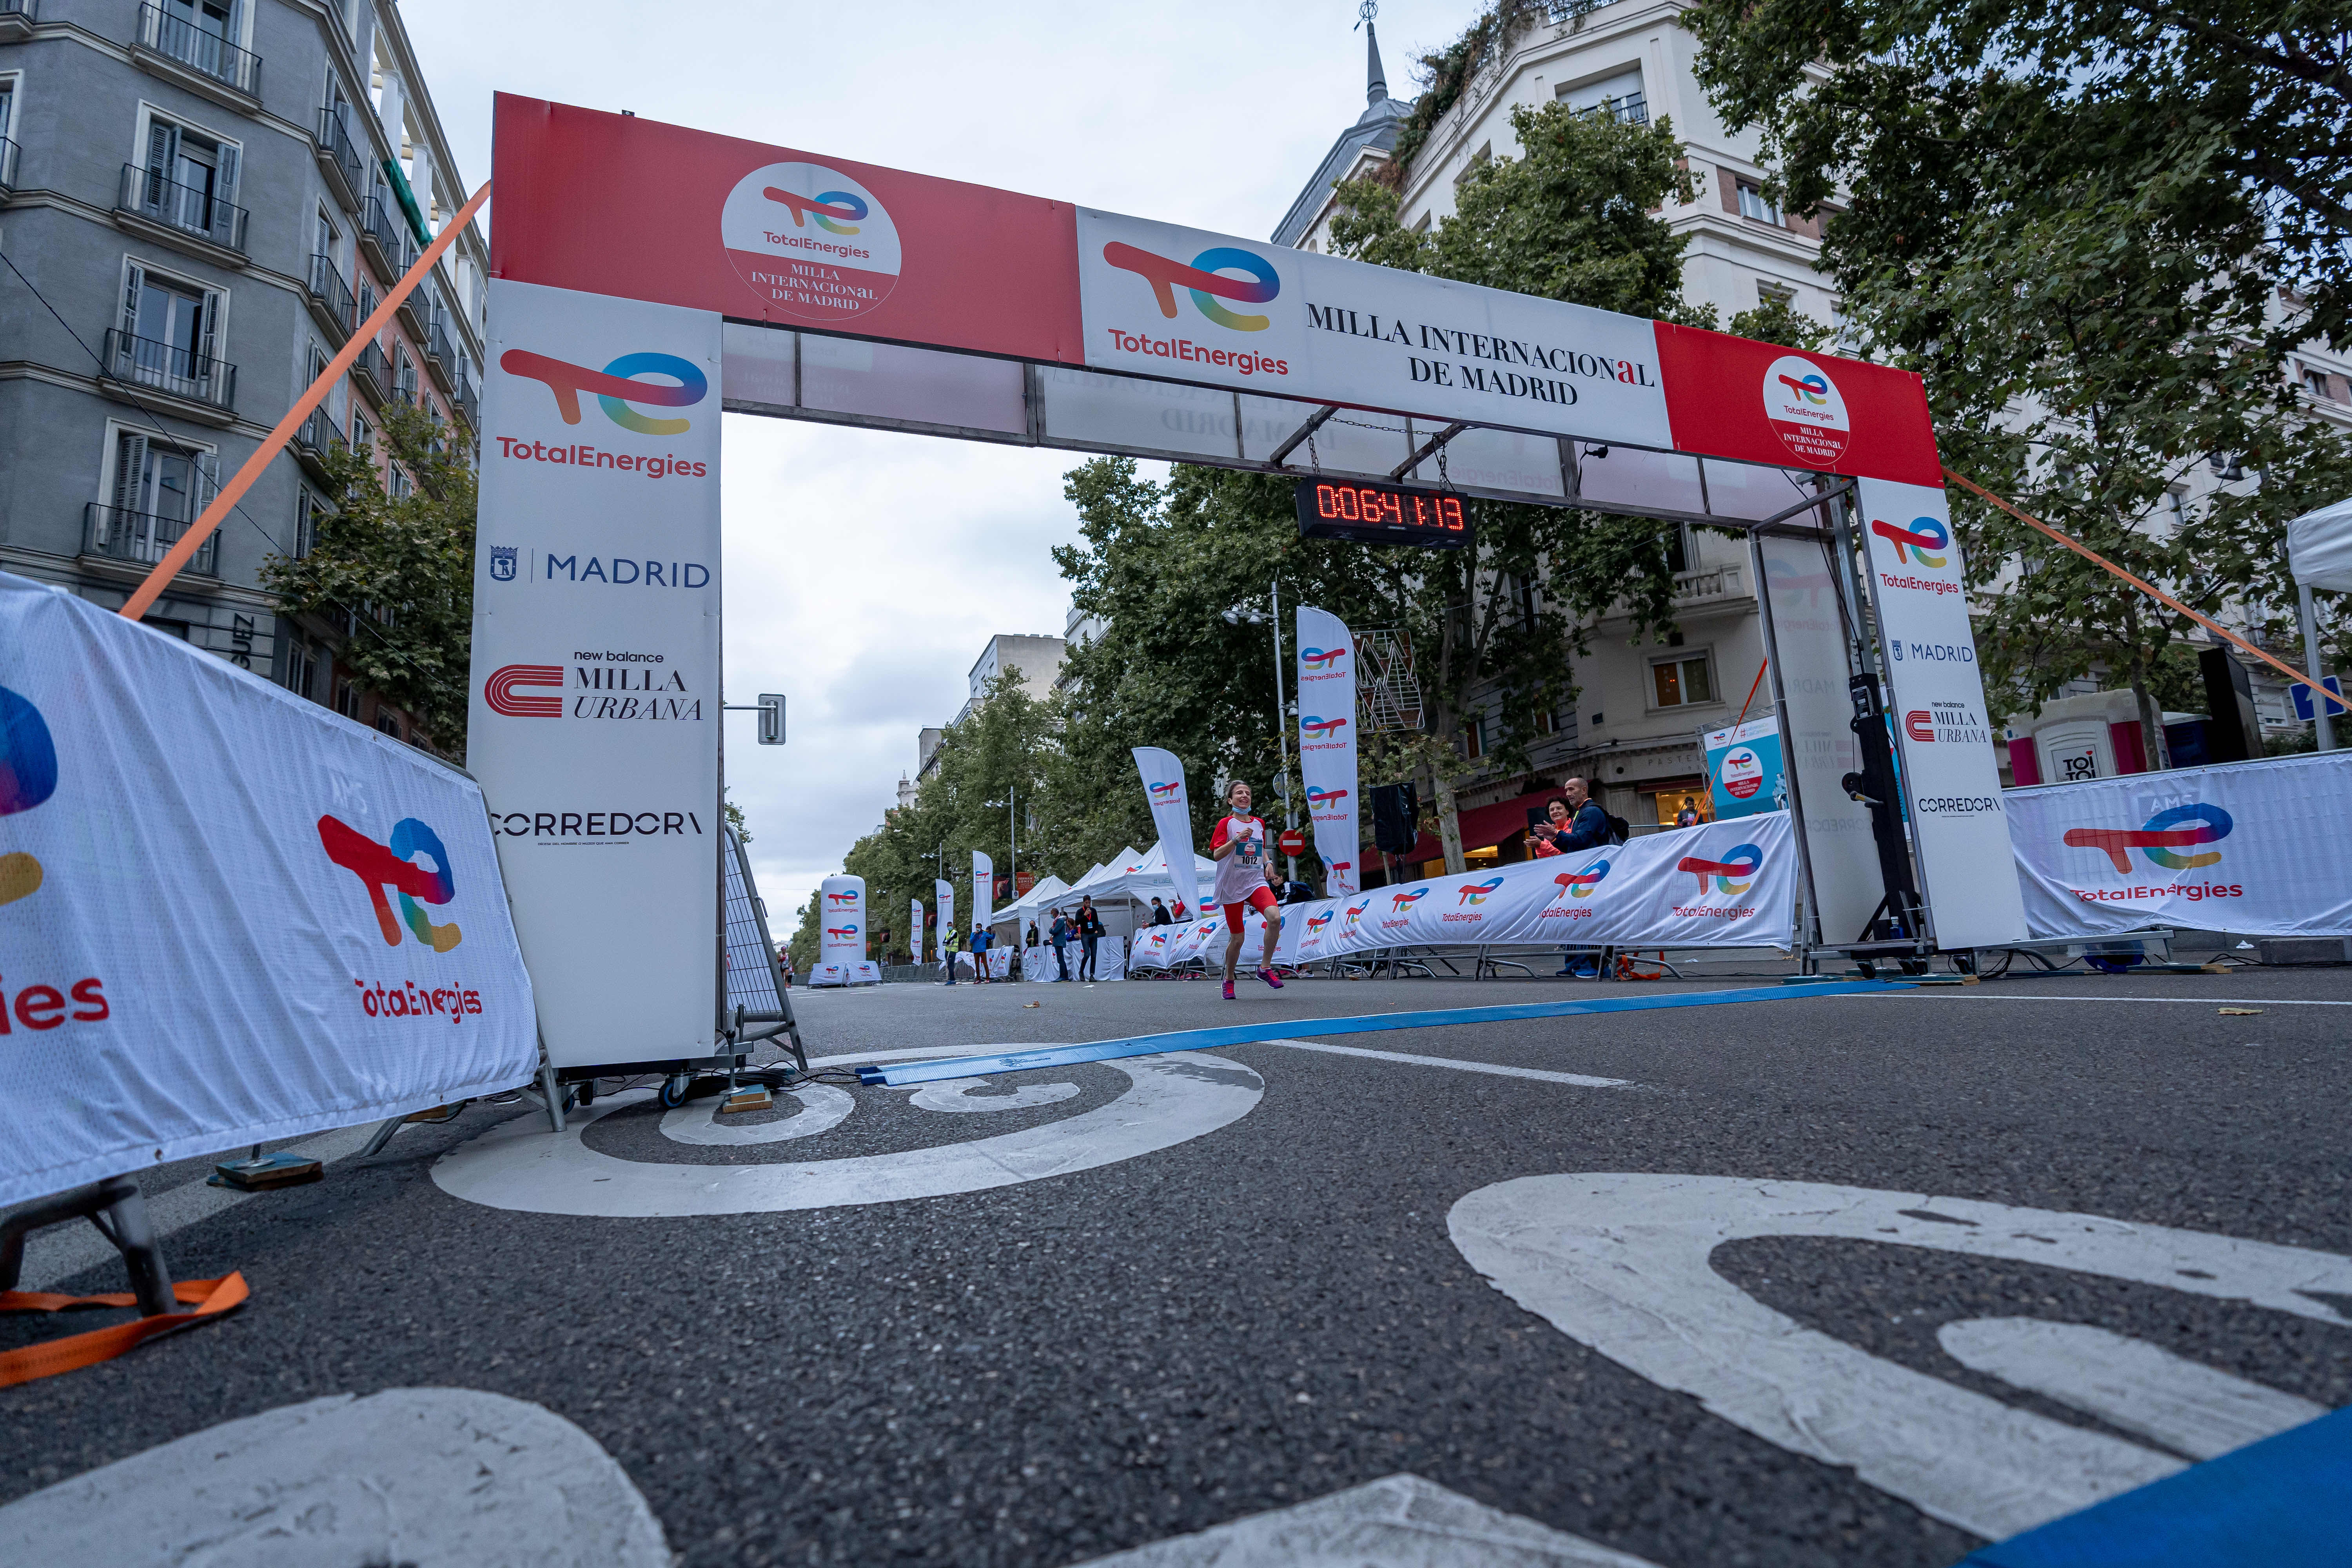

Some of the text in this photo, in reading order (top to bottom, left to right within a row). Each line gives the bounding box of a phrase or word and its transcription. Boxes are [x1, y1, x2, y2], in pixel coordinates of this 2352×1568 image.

[763, 231, 870, 259] TotalEnergies
[790, 263, 841, 281] MILLA
[771, 288, 860, 310] DE MADRID
[1305, 302, 1414, 346] MILLA
[1108, 328, 1288, 375] TotalEnergies
[1407, 356, 1579, 405] DE MADRID
[1784, 405, 1834, 421] TotalEnergies
[1800, 426, 1824, 437] MILLA
[496, 436, 706, 479] TotalEnergies
[1795, 445, 1836, 457] DE MADRID
[547, 554, 710, 588] MADRID
[1880, 573, 1958, 595] TotalEnergies
[574, 651, 664, 663] new balance
[1911, 643, 1973, 662] MADRID
[573, 667, 689, 692] MILLA
[573, 696, 704, 721] URBANA
[1933, 711, 1977, 726] MILLA
[1938, 729, 1987, 743] URBANA
[1242, 856, 1258, 865] 1012
[1443, 911, 1483, 923] TotalEnergies
[1672, 905, 1755, 921] TotalEnergies
[1382, 917, 1409, 929] TotalEnergies
